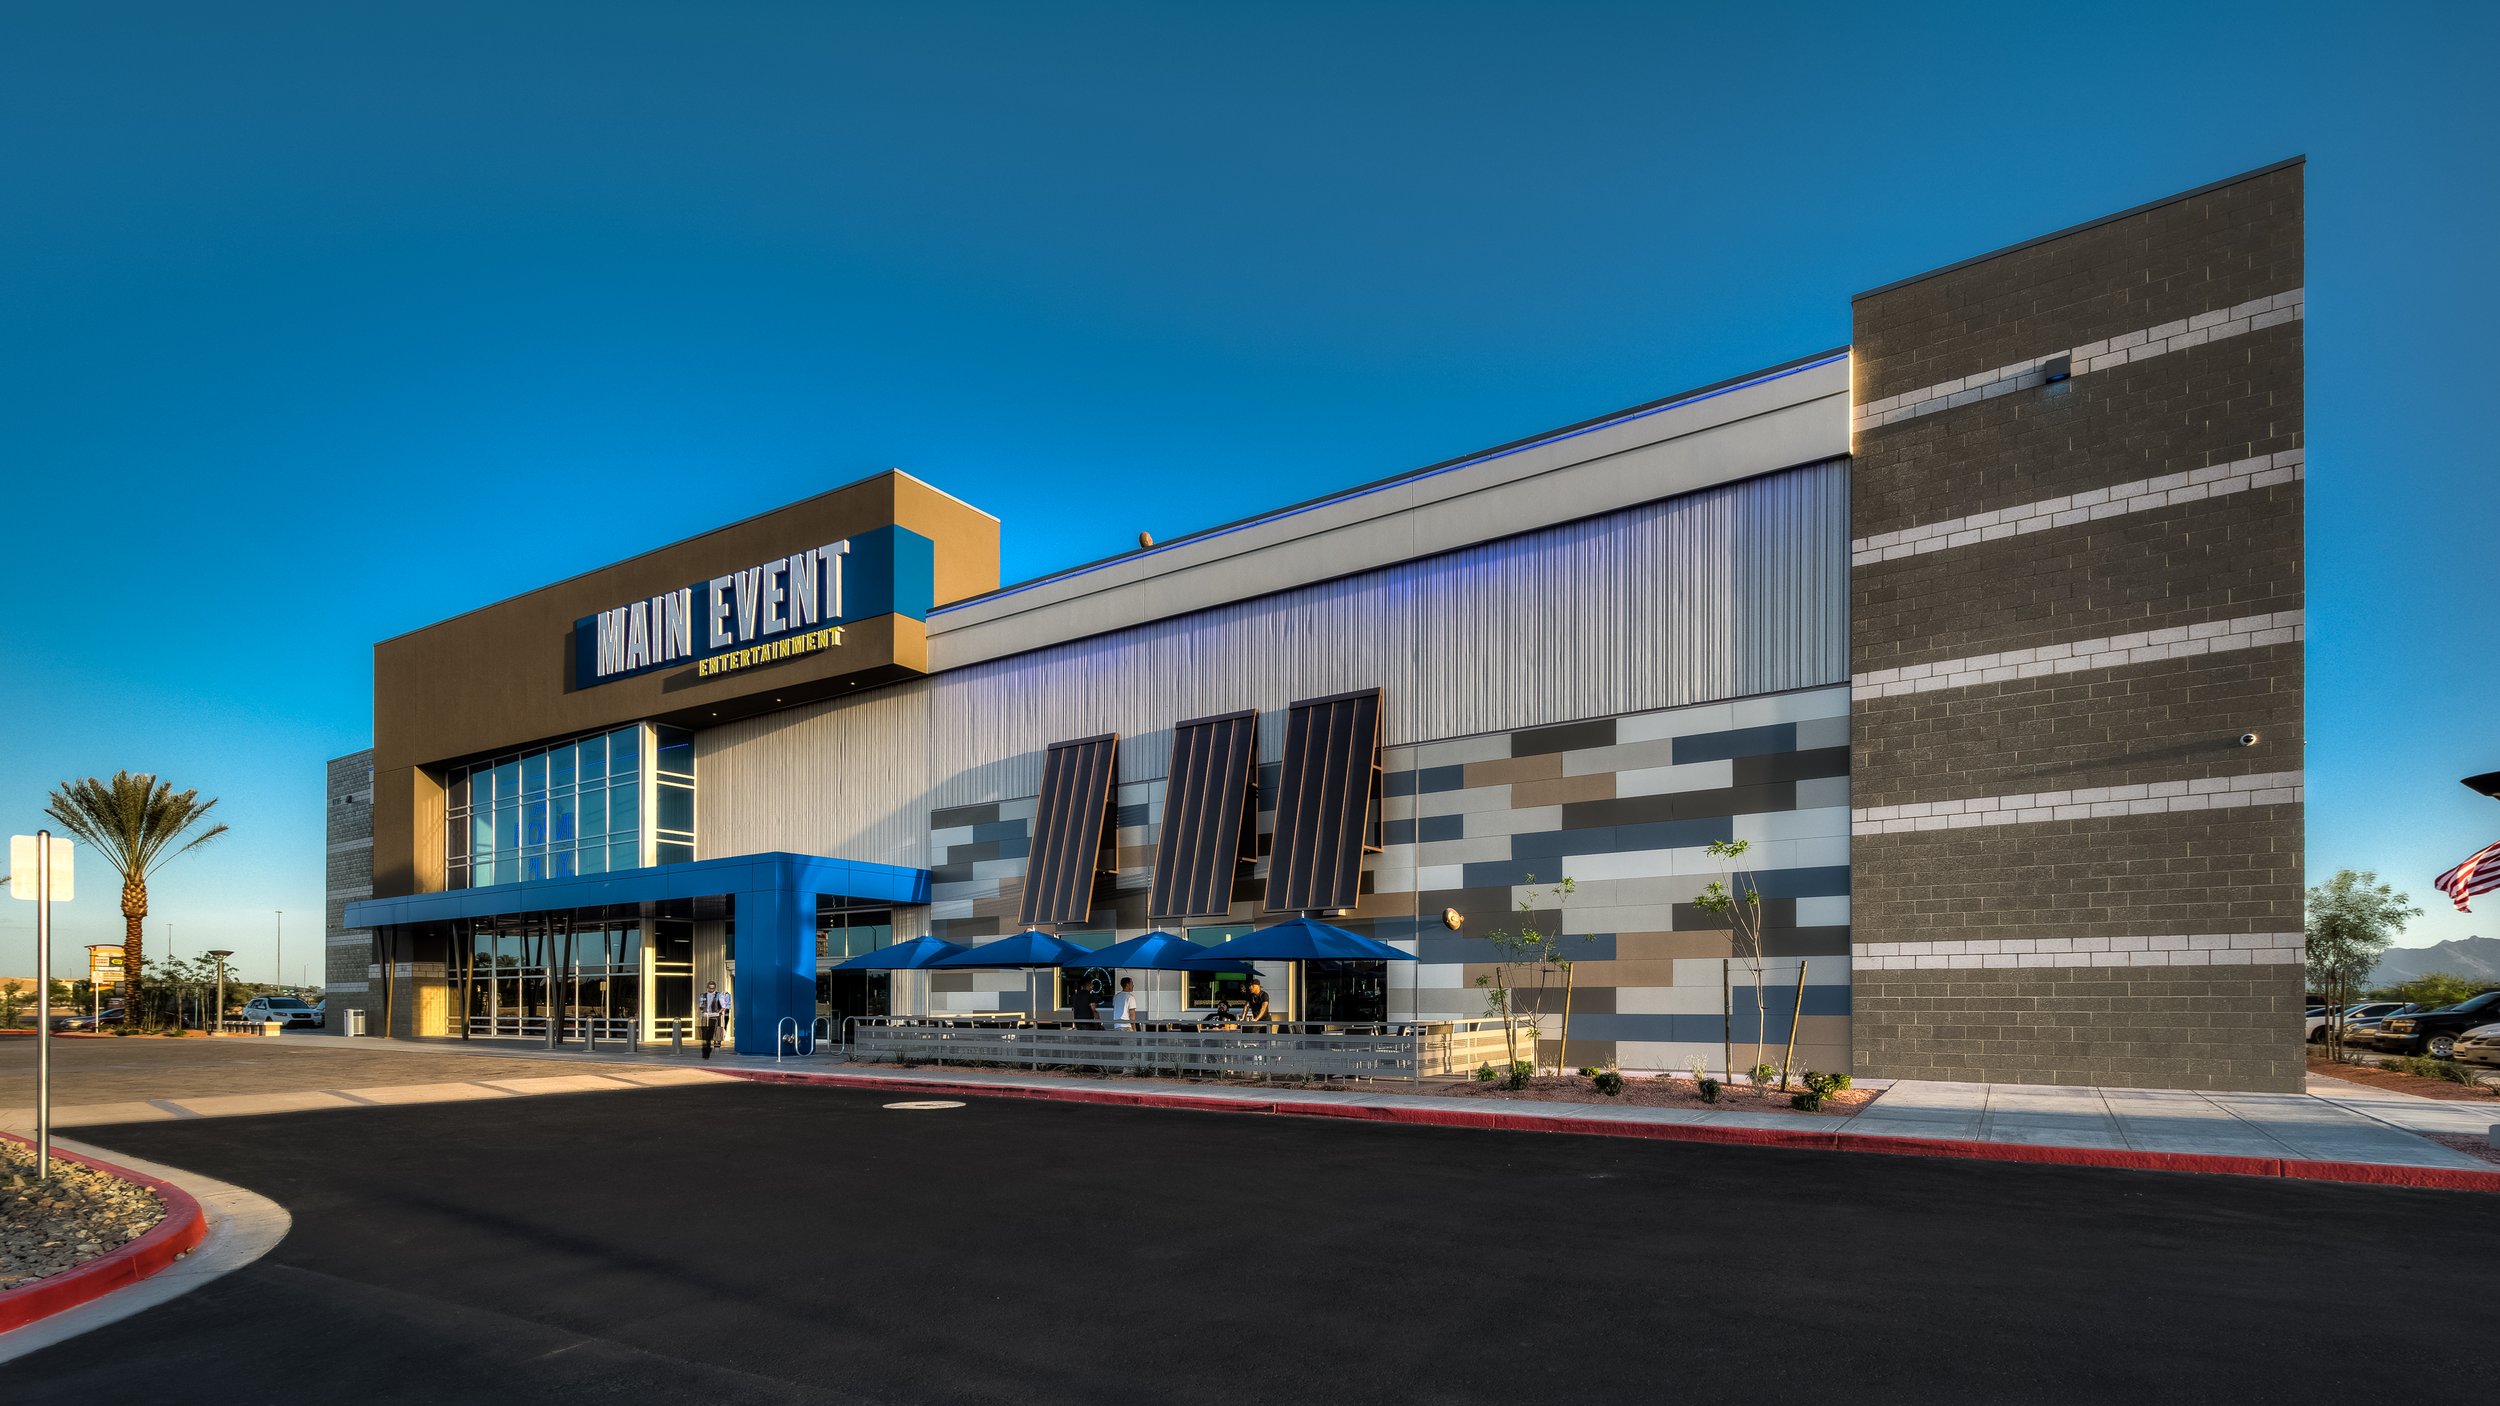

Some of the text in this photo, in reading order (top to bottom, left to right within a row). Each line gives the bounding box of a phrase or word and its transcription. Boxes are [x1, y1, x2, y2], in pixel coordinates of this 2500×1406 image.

[597, 539, 850, 677] MAIN EVENT
[699, 625, 845, 677] ENTERTAINMENT
